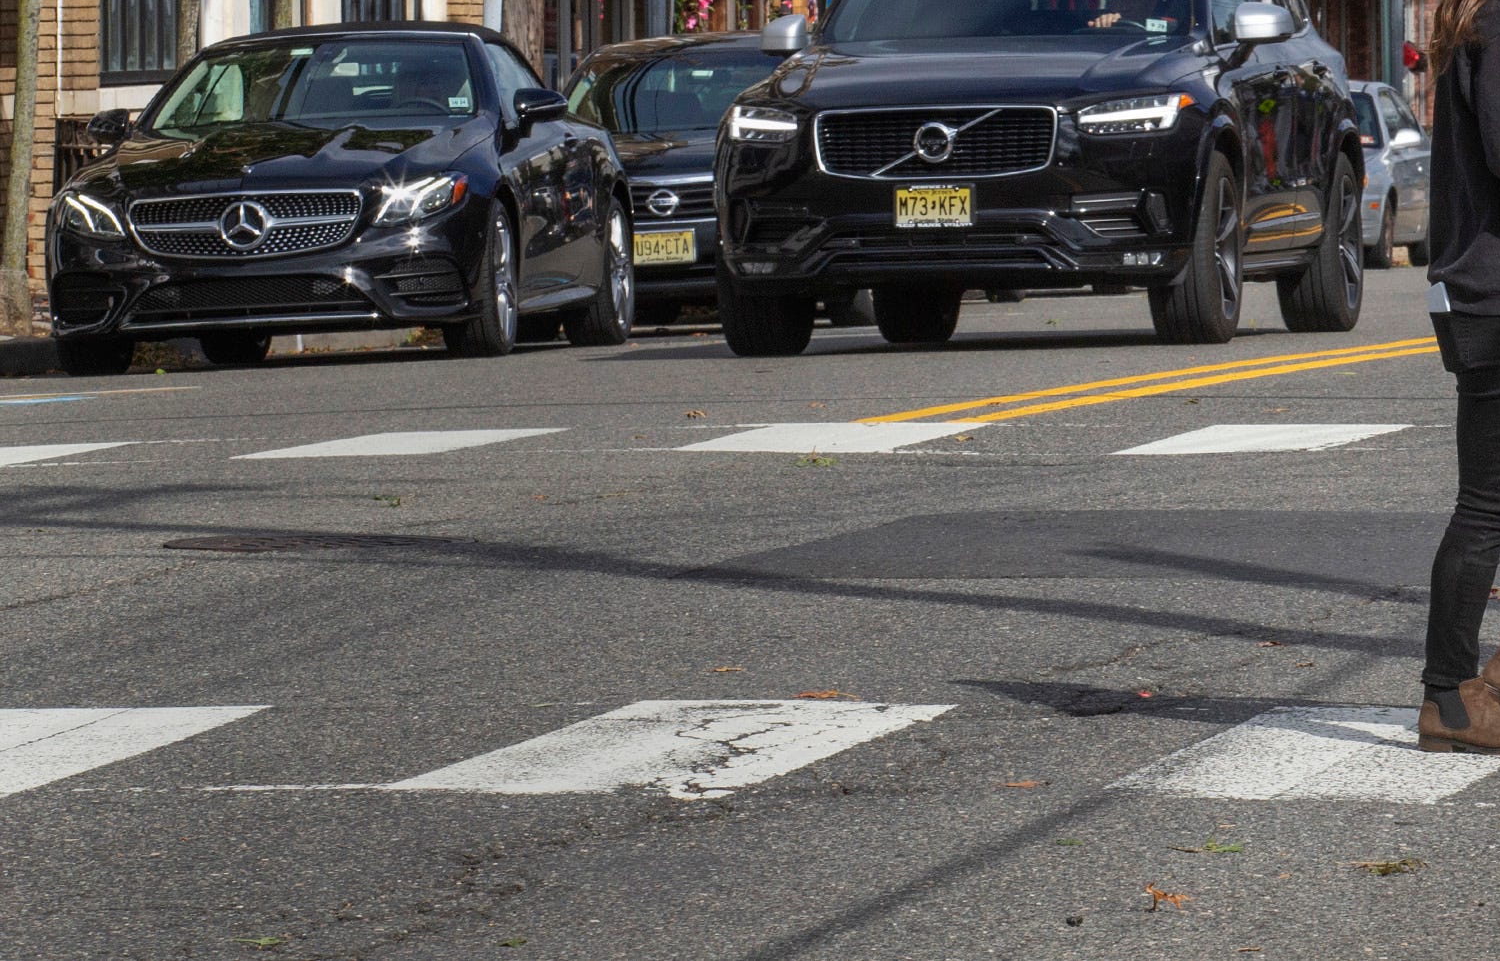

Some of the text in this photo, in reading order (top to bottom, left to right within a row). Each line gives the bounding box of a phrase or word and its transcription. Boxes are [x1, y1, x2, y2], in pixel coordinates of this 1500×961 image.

[898, 195, 968, 217] M73 KFX
[635, 238, 690, 257] U94 CTA
